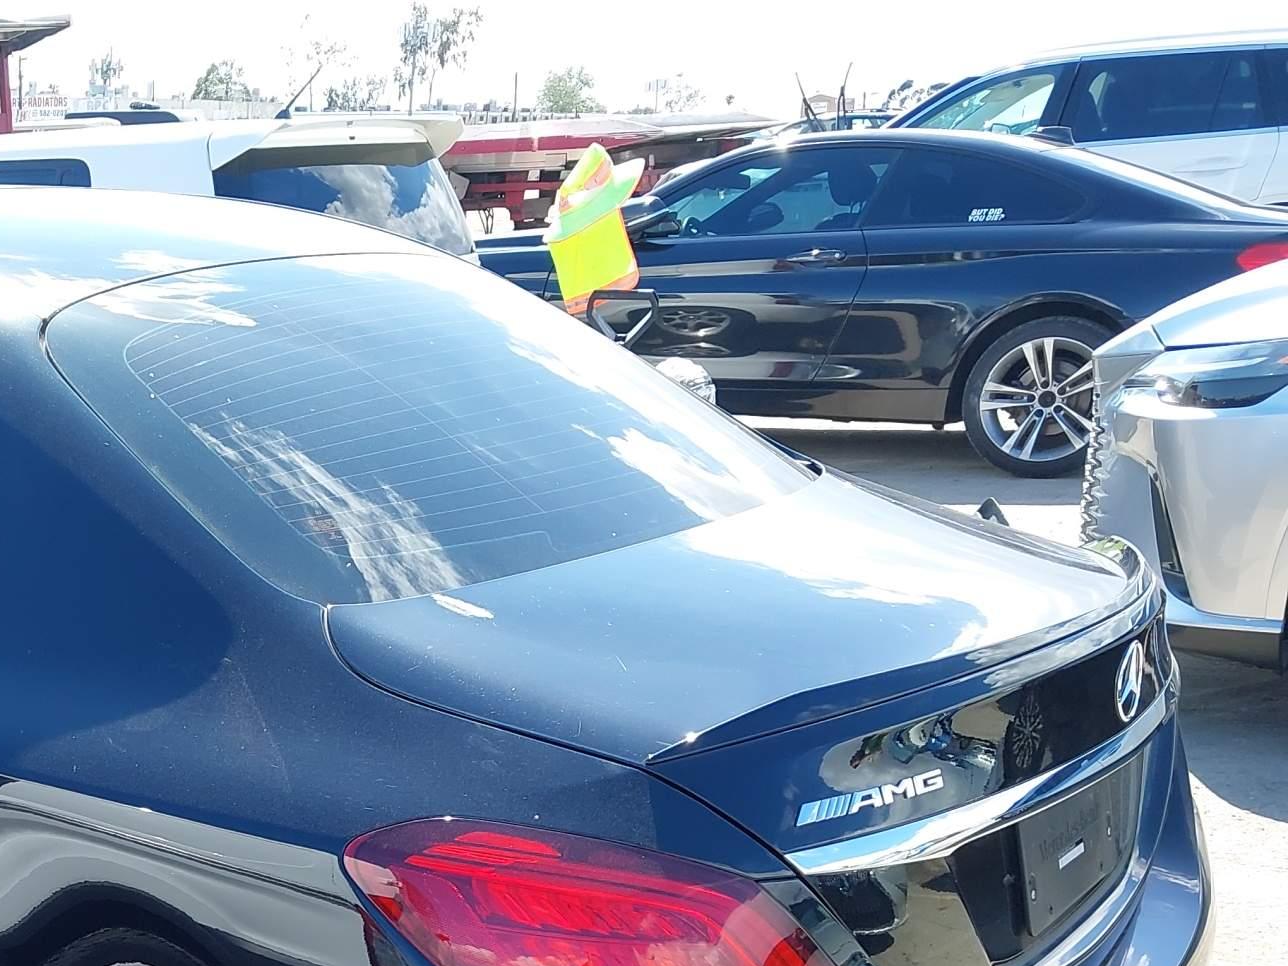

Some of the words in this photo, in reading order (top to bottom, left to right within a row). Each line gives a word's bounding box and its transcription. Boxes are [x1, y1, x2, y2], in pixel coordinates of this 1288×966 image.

[27, 97, 68, 108] RADIATORS
[971, 208, 988, 216] BUT
[988, 207, 1004, 215] DID
[985, 213, 1006, 222] DIE?
[848, 767, 945, 814] AMG
